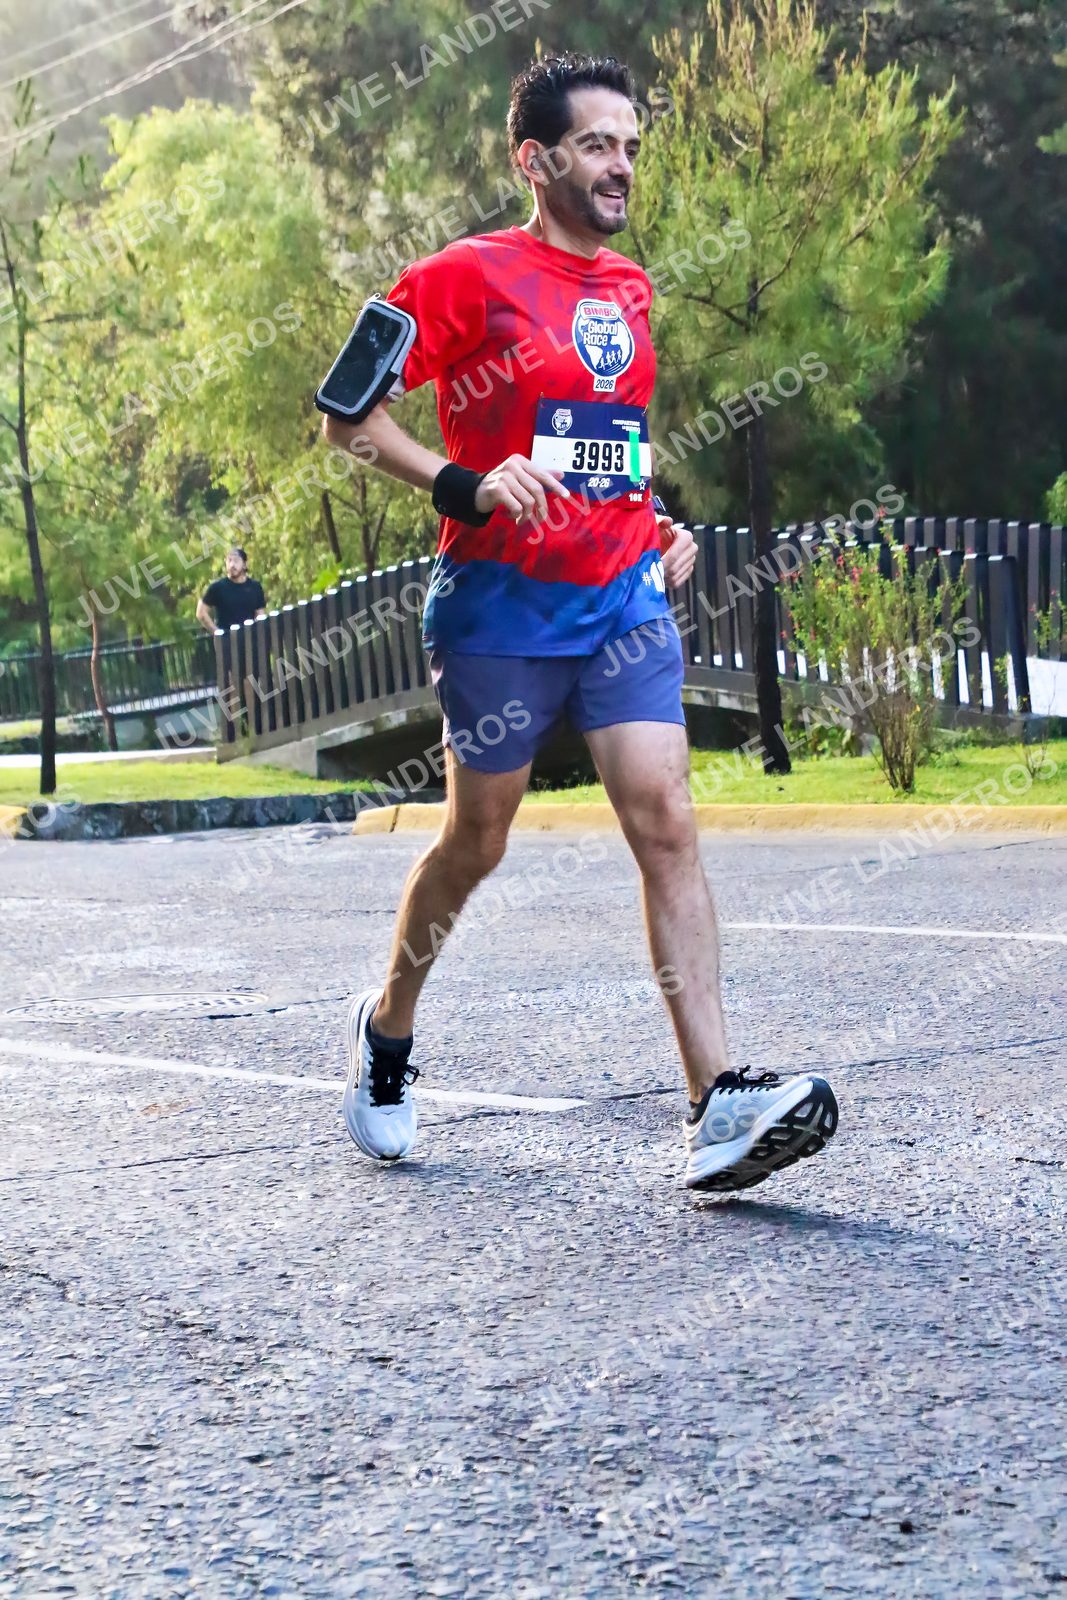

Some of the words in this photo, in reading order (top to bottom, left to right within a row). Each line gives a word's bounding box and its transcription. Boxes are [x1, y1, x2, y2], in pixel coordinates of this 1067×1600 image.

[584, 307, 616, 317] BIMBO
[588, 320, 618, 335] Global
[583, 332, 608, 346] Race
[595, 379, 615, 389] 2026
[572, 441, 624, 472] 3993
[629, 493, 643, 502] 10K
